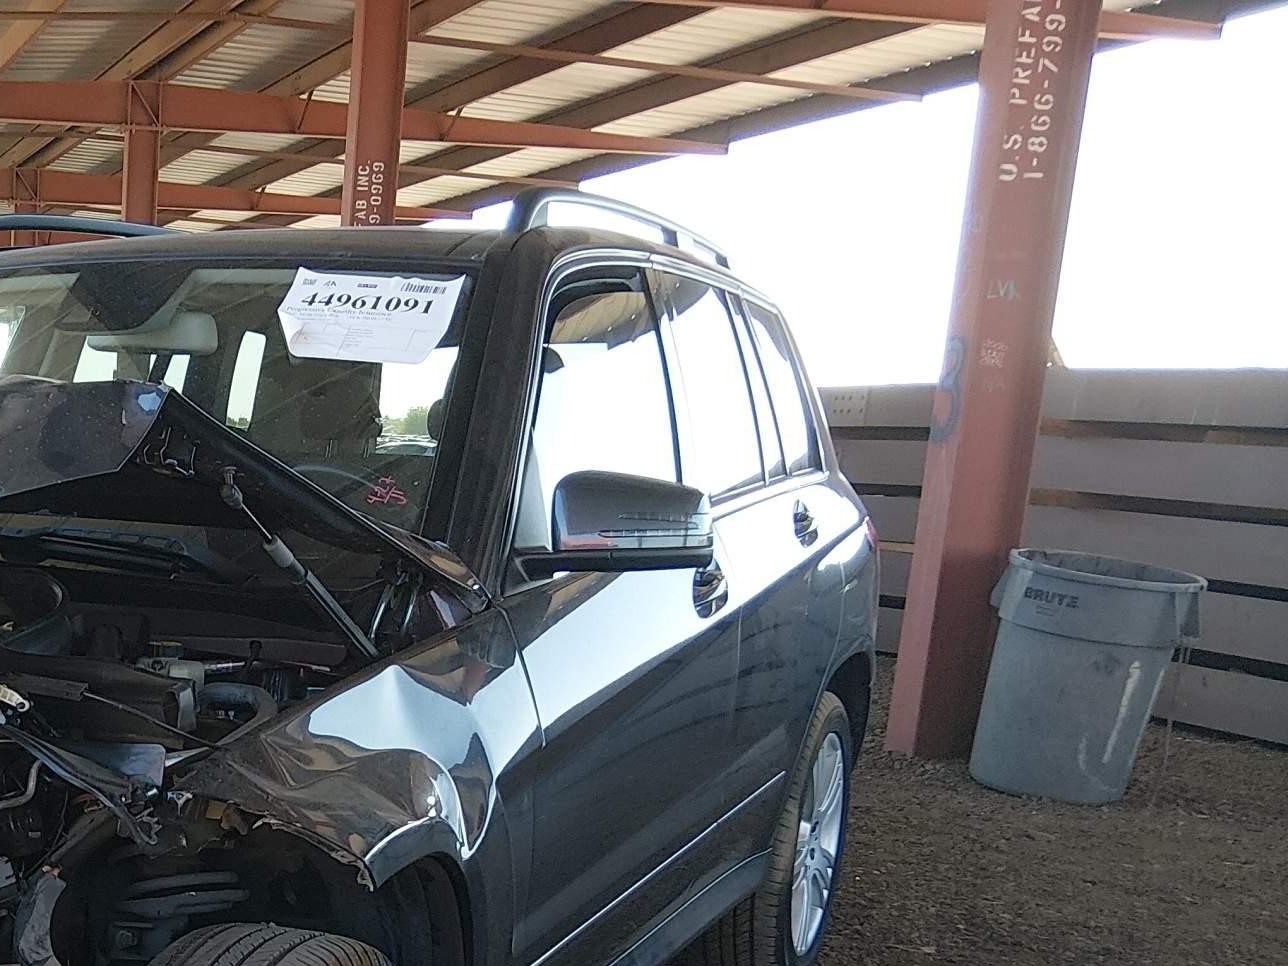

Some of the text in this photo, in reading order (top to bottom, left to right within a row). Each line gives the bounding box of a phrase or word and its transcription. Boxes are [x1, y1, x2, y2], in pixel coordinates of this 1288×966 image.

[999, 0, 1043, 182] U.S. PREFA
[356, 160, 370, 191] INC.
[301, 292, 434, 314] 44961091
[1024, 586, 1079, 608] BRUTE
